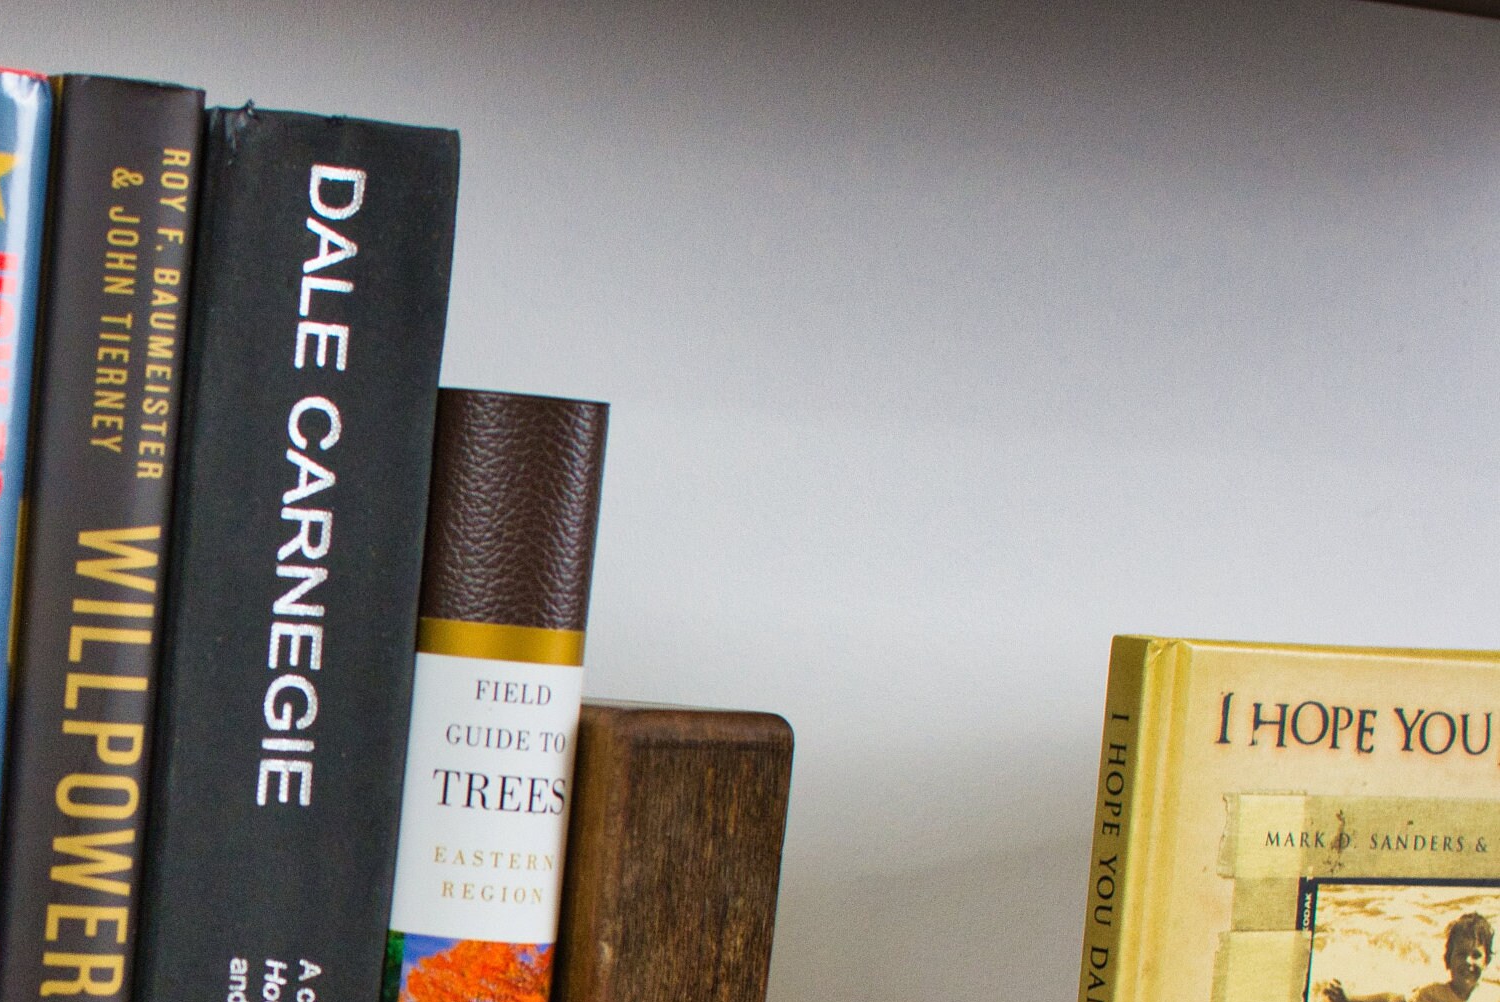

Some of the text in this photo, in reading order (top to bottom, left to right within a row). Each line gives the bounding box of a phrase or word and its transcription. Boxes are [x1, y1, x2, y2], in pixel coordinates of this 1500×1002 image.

[90, 166, 144, 453] & JOHN TIERNEY
[136, 148, 192, 479] ROY F. BAUMEISTER
[257, 164, 367, 806] DALE CARNEGIE
[475, 680, 551, 705] FIELD
[446, 723, 566, 753] GUIDE TO
[1112, 713, 1129, 722] I
[1214, 692, 1492, 755] I HOPE YOU
[39, 526, 161, 997] WILLPOWER
[432, 769, 566, 815] TREES
[1102, 742, 1127, 837] HOPE
[434, 846, 554, 870] EASTERN
[1265, 831, 1488, 853] MARK D. SANDERS &
[441, 881, 543, 904] REGION
[1093, 854, 1117, 926] YOU
[299, 958, 322, 981] A
